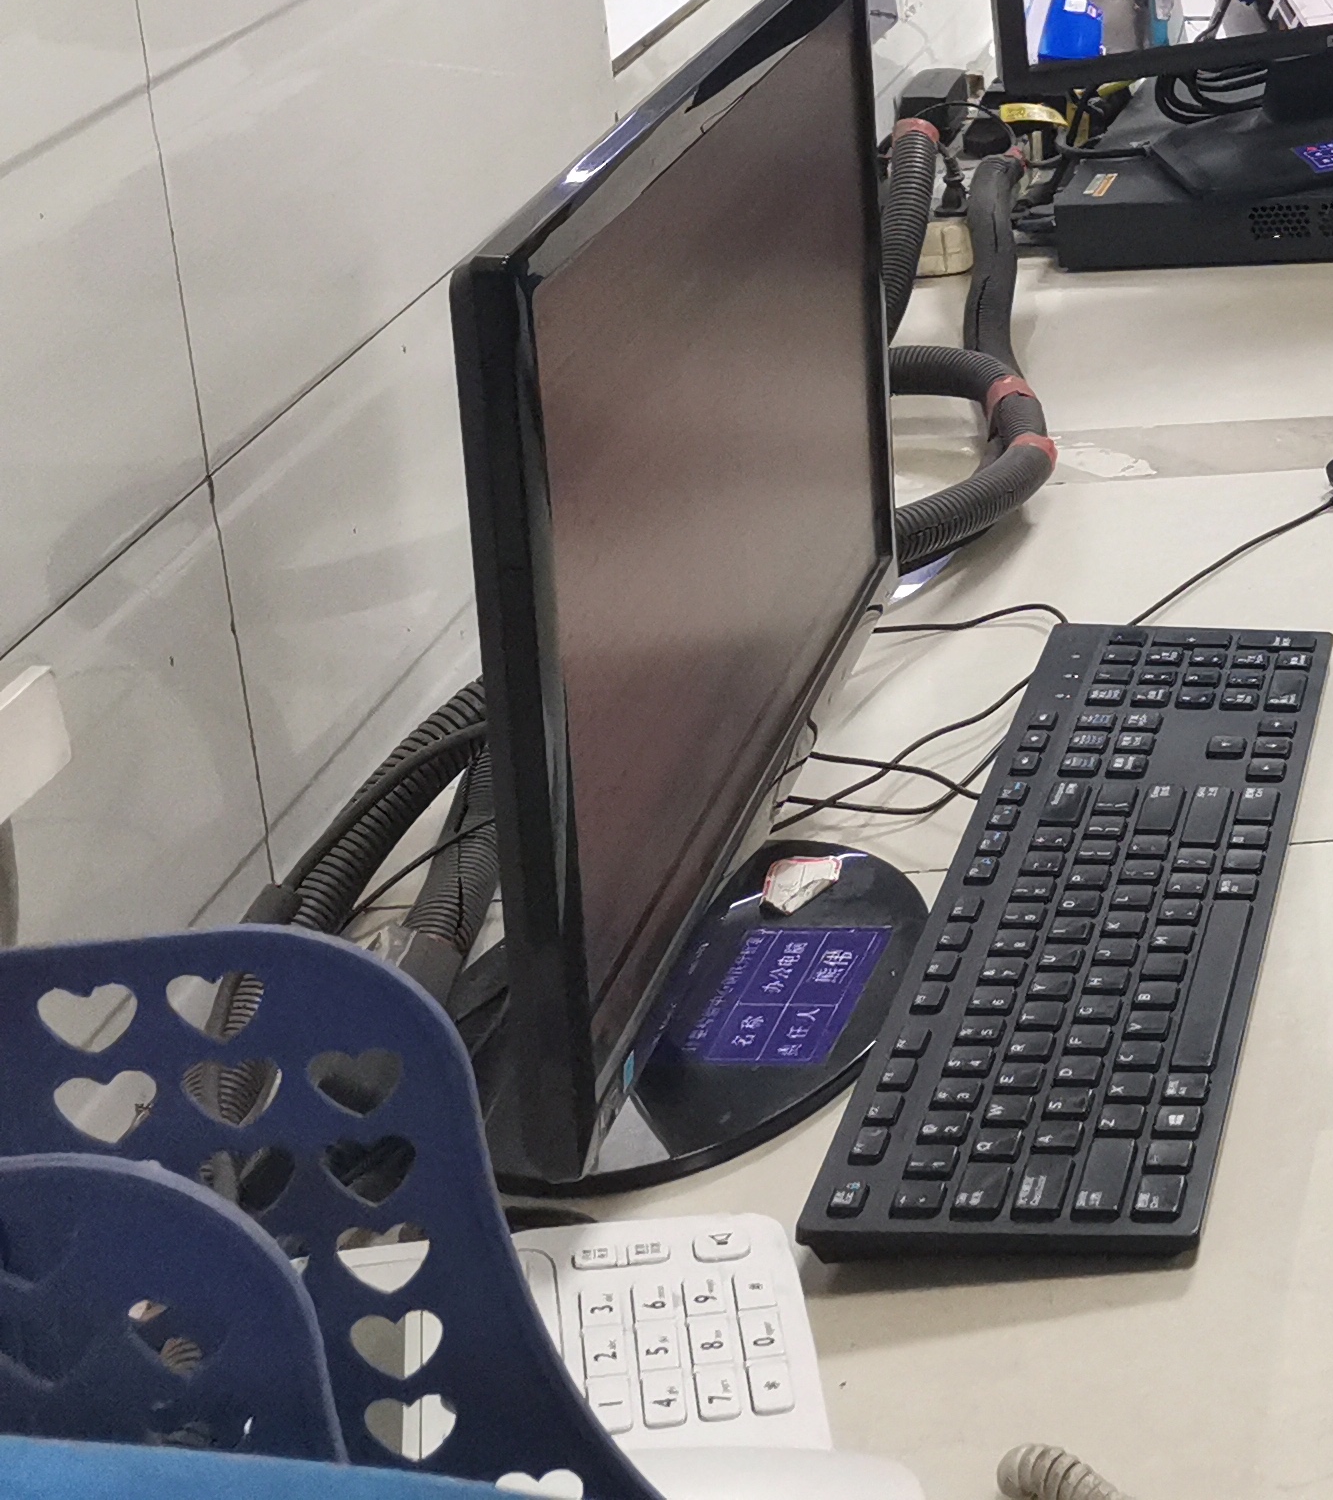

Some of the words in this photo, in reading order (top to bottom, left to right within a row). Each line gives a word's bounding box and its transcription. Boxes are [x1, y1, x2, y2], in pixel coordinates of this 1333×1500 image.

[761, 941, 808, 994] 办公电脑
[731, 1014, 765, 1048] 名称
[777, 1008, 821, 1056] 责任人
